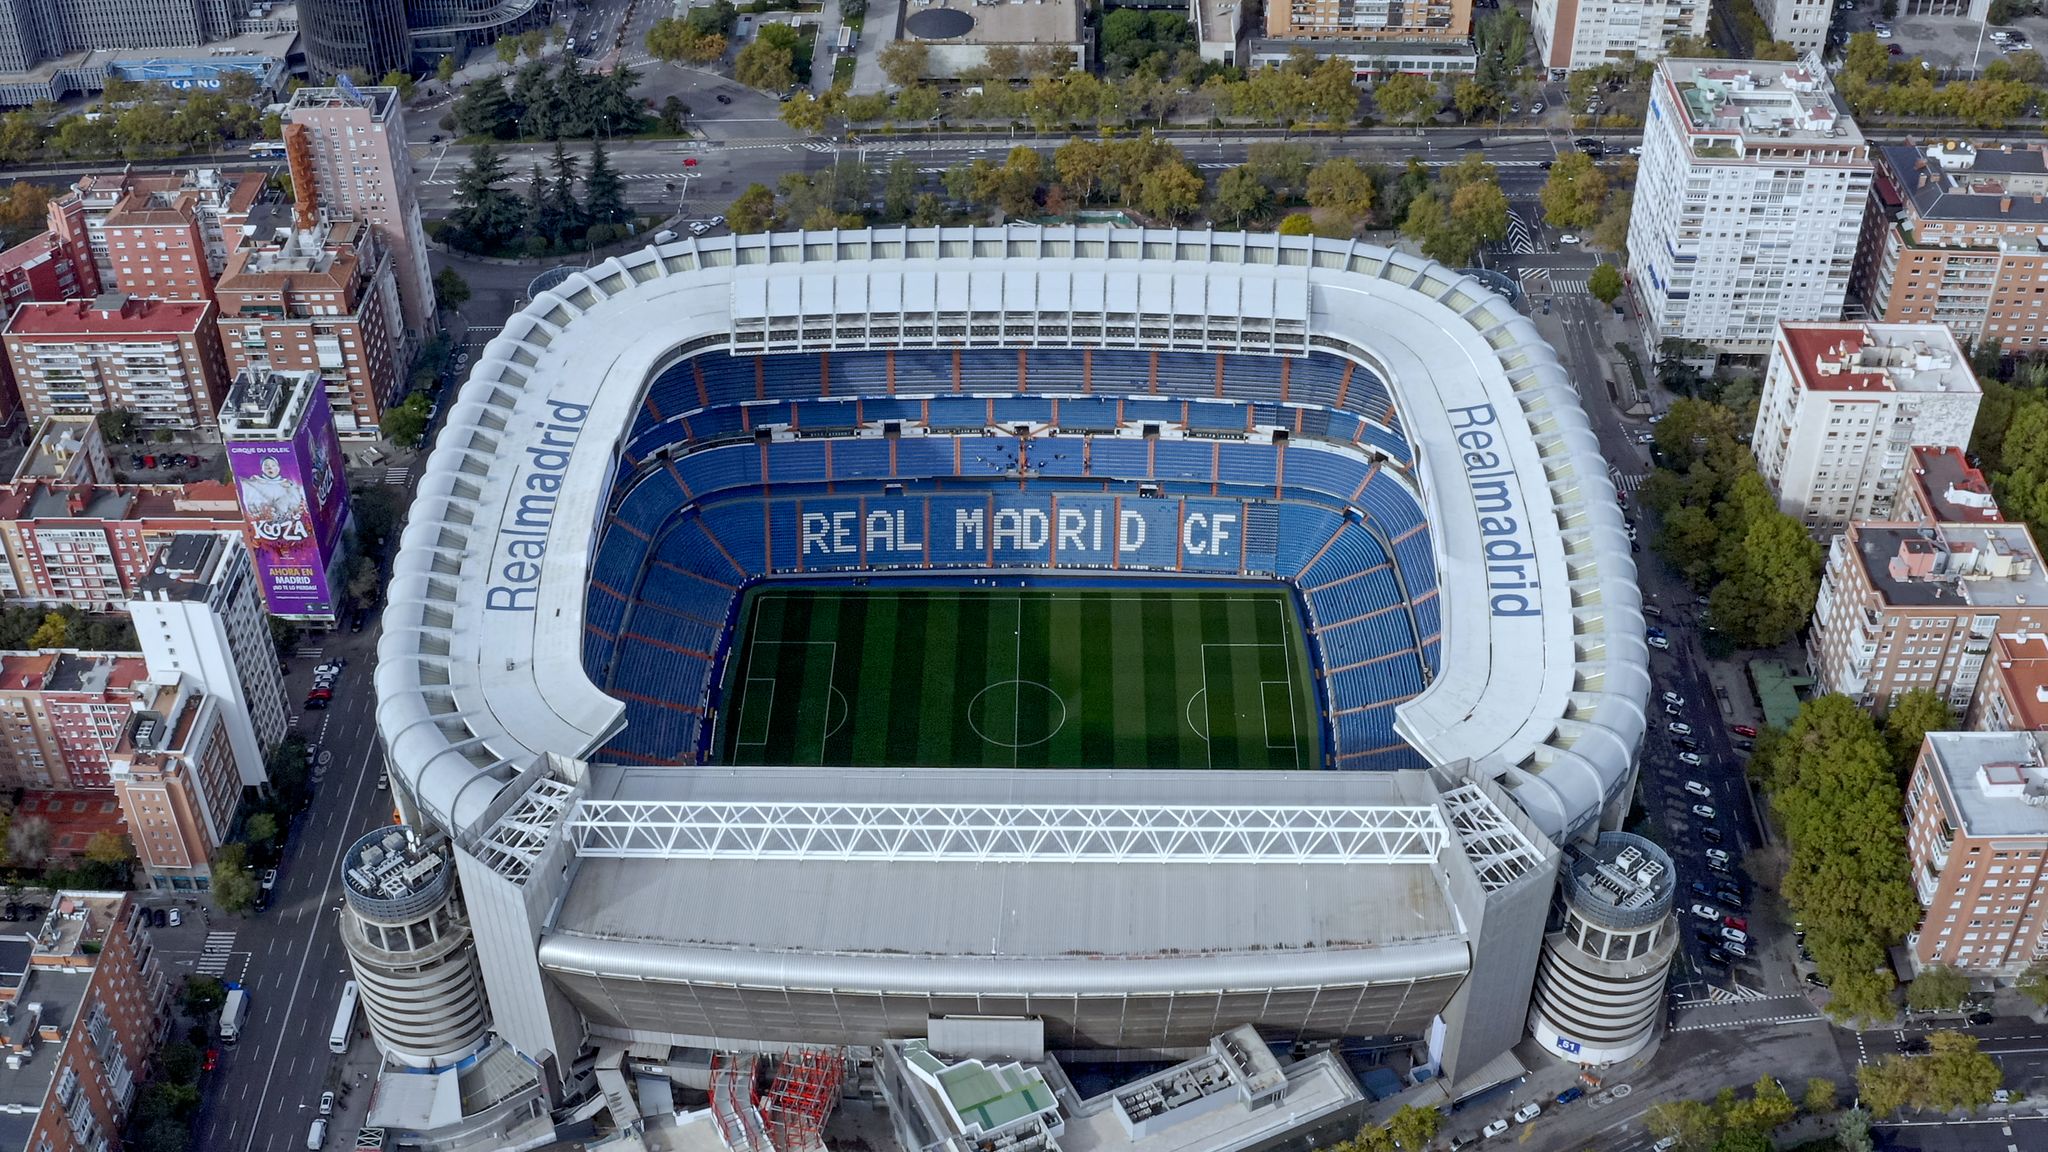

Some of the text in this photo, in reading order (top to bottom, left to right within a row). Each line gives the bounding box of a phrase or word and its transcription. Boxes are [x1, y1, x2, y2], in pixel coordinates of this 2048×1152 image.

[802, 505, 922, 554] REAL
[956, 503, 1146, 552] MADRID
[269, 568, 313, 576] AHORA EN
[275, 576, 311, 584] MADRID
[1562, 1040, 1576, 1051] 51
